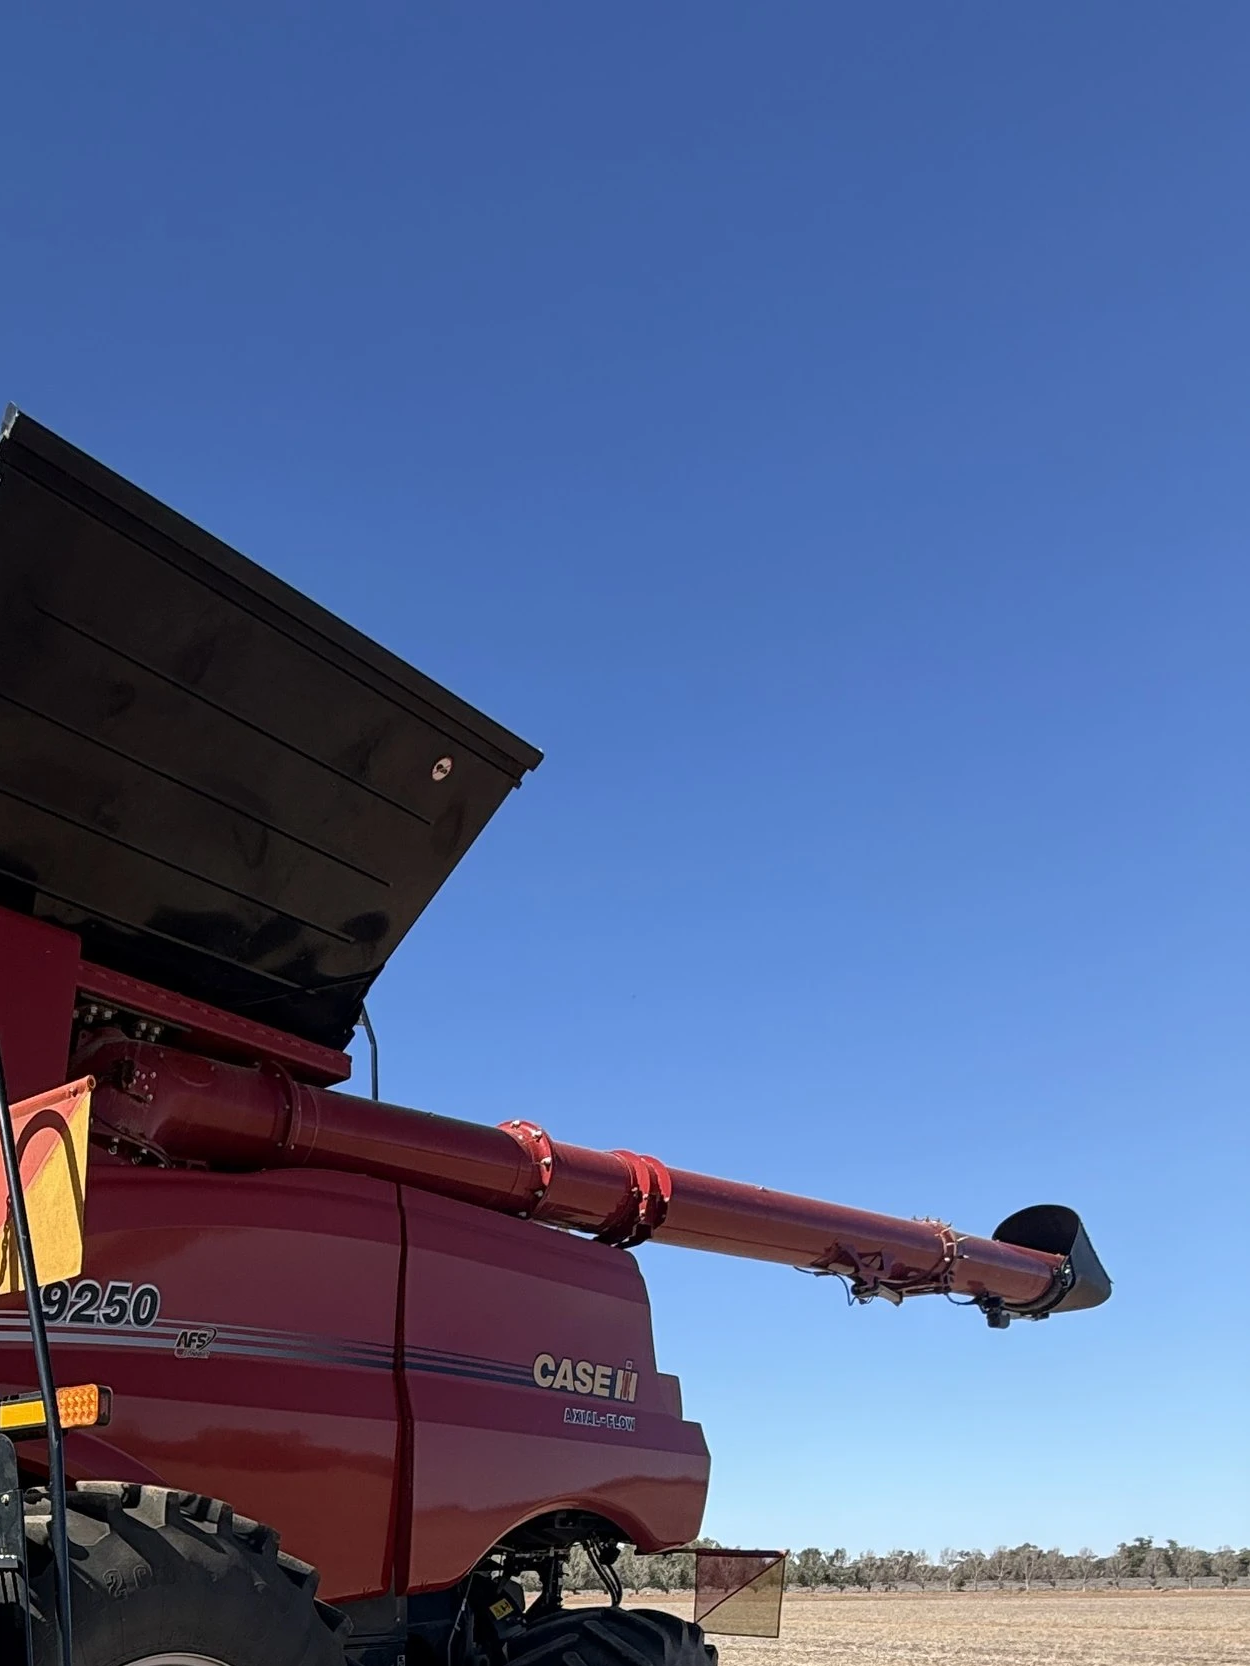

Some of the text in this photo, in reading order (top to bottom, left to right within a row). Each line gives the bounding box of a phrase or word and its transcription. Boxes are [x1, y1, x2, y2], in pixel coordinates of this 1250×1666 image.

[40, 1279, 161, 1329] 9250
[176, 1330, 210, 1349] AFS
[532, 1353, 613, 1398] CASE
[563, 1407, 636, 1432] AXIAL-FLOW
